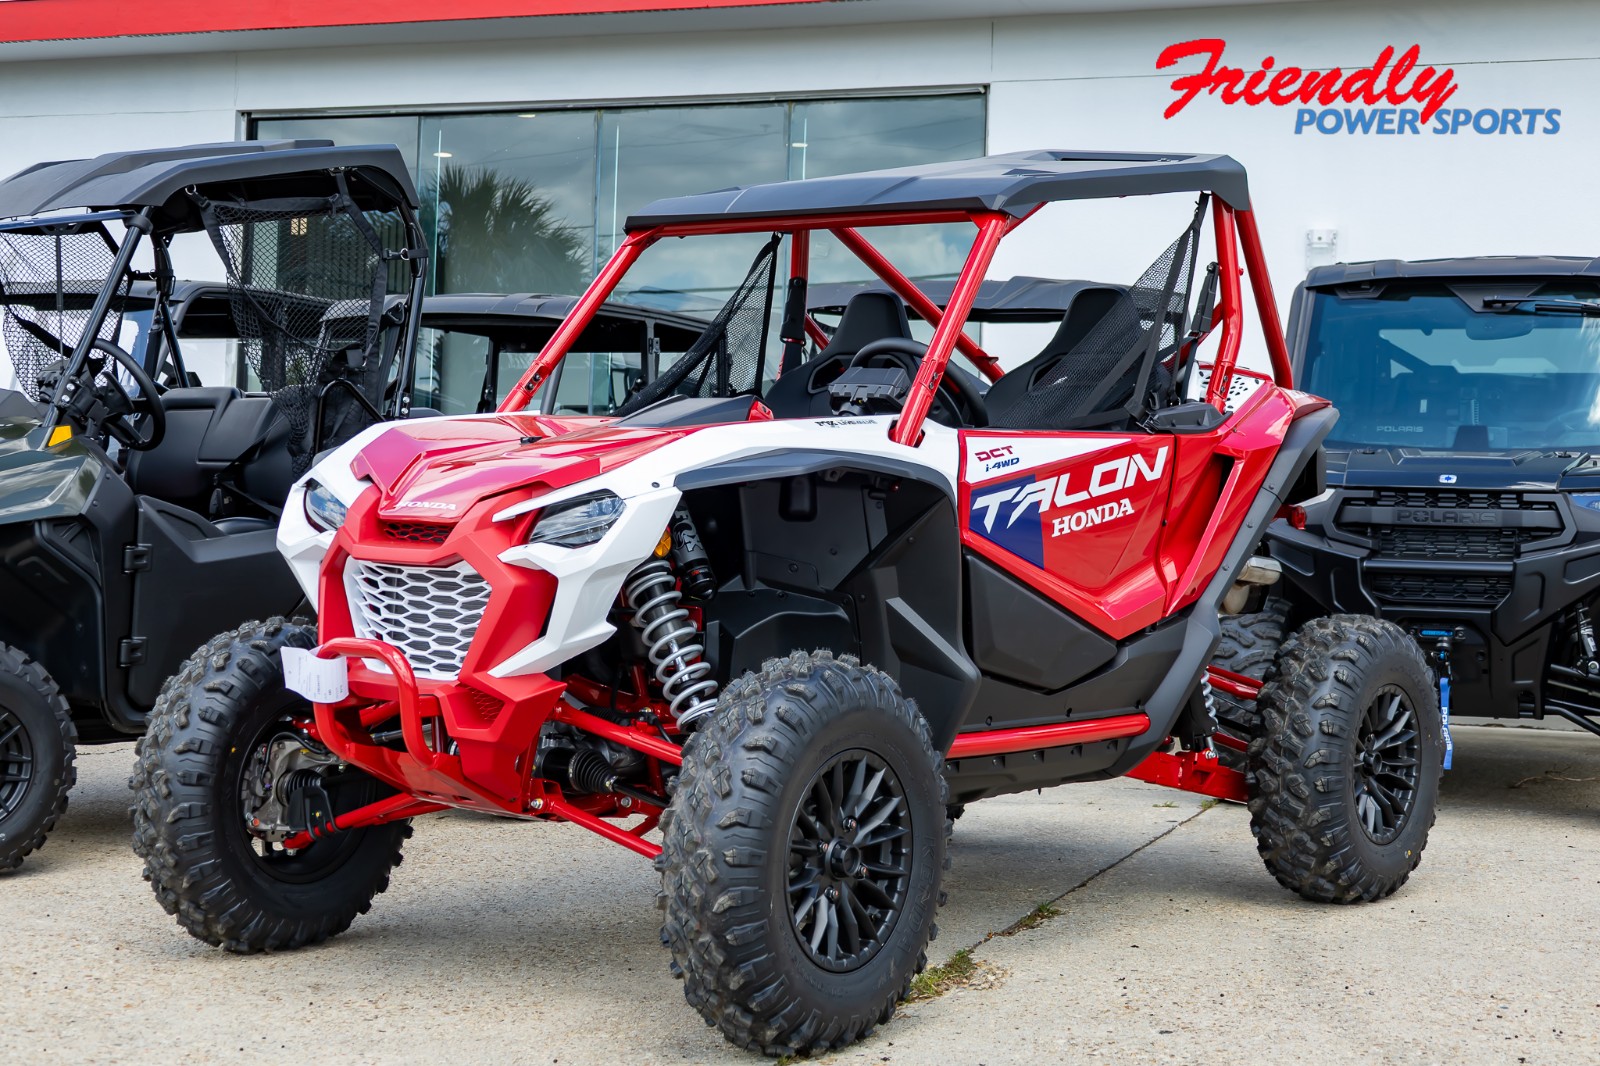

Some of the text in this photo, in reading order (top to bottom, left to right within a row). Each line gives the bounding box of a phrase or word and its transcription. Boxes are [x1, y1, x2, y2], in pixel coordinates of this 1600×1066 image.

[1156, 39, 1458, 124] Friendly
[1294, 109, 1561, 135] POWER SPORTS
[1376, 425, 1424, 433] POLARIS
[975, 445, 1013, 462] DCT
[972, 446, 1169, 534] TALON
[396, 501, 457, 511] HONDA
[1051, 498, 1135, 538] HONDA
[1396, 510, 1497, 524] POLARIS
[1441, 706, 1453, 751] POLARIS
